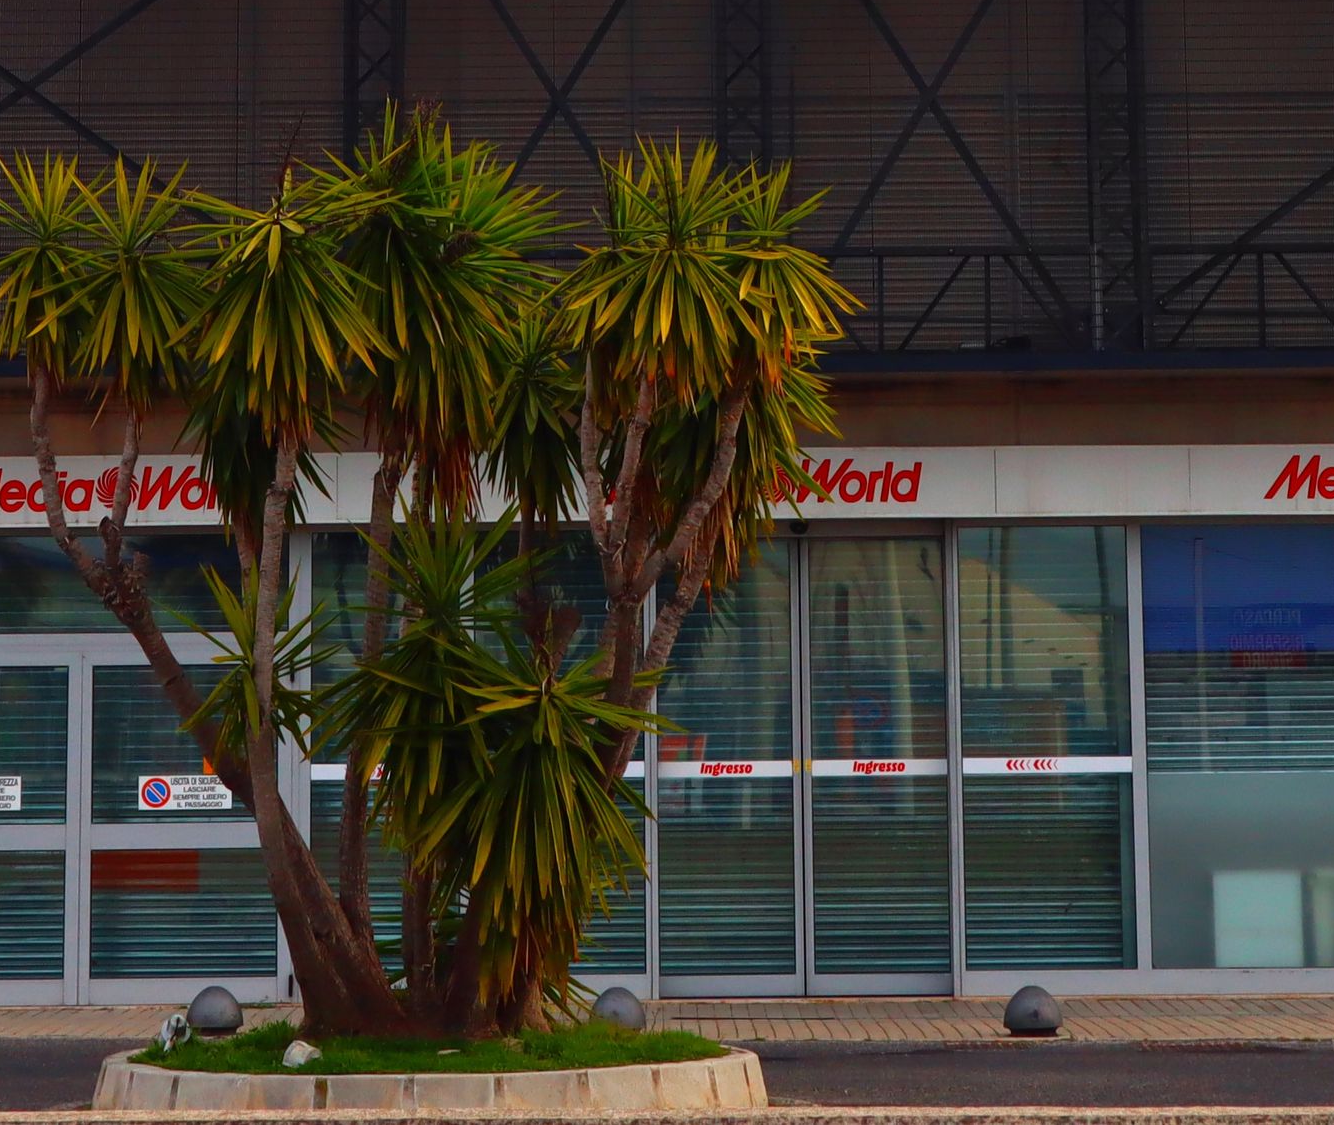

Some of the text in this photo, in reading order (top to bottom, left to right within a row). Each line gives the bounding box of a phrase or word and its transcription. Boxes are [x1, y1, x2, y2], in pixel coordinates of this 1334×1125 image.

[137, 465, 218, 511] Wor
[170, 777, 190, 786] USCITA
[191, 777, 197, 786] DI
[202, 793, 227, 801] LIBERO
